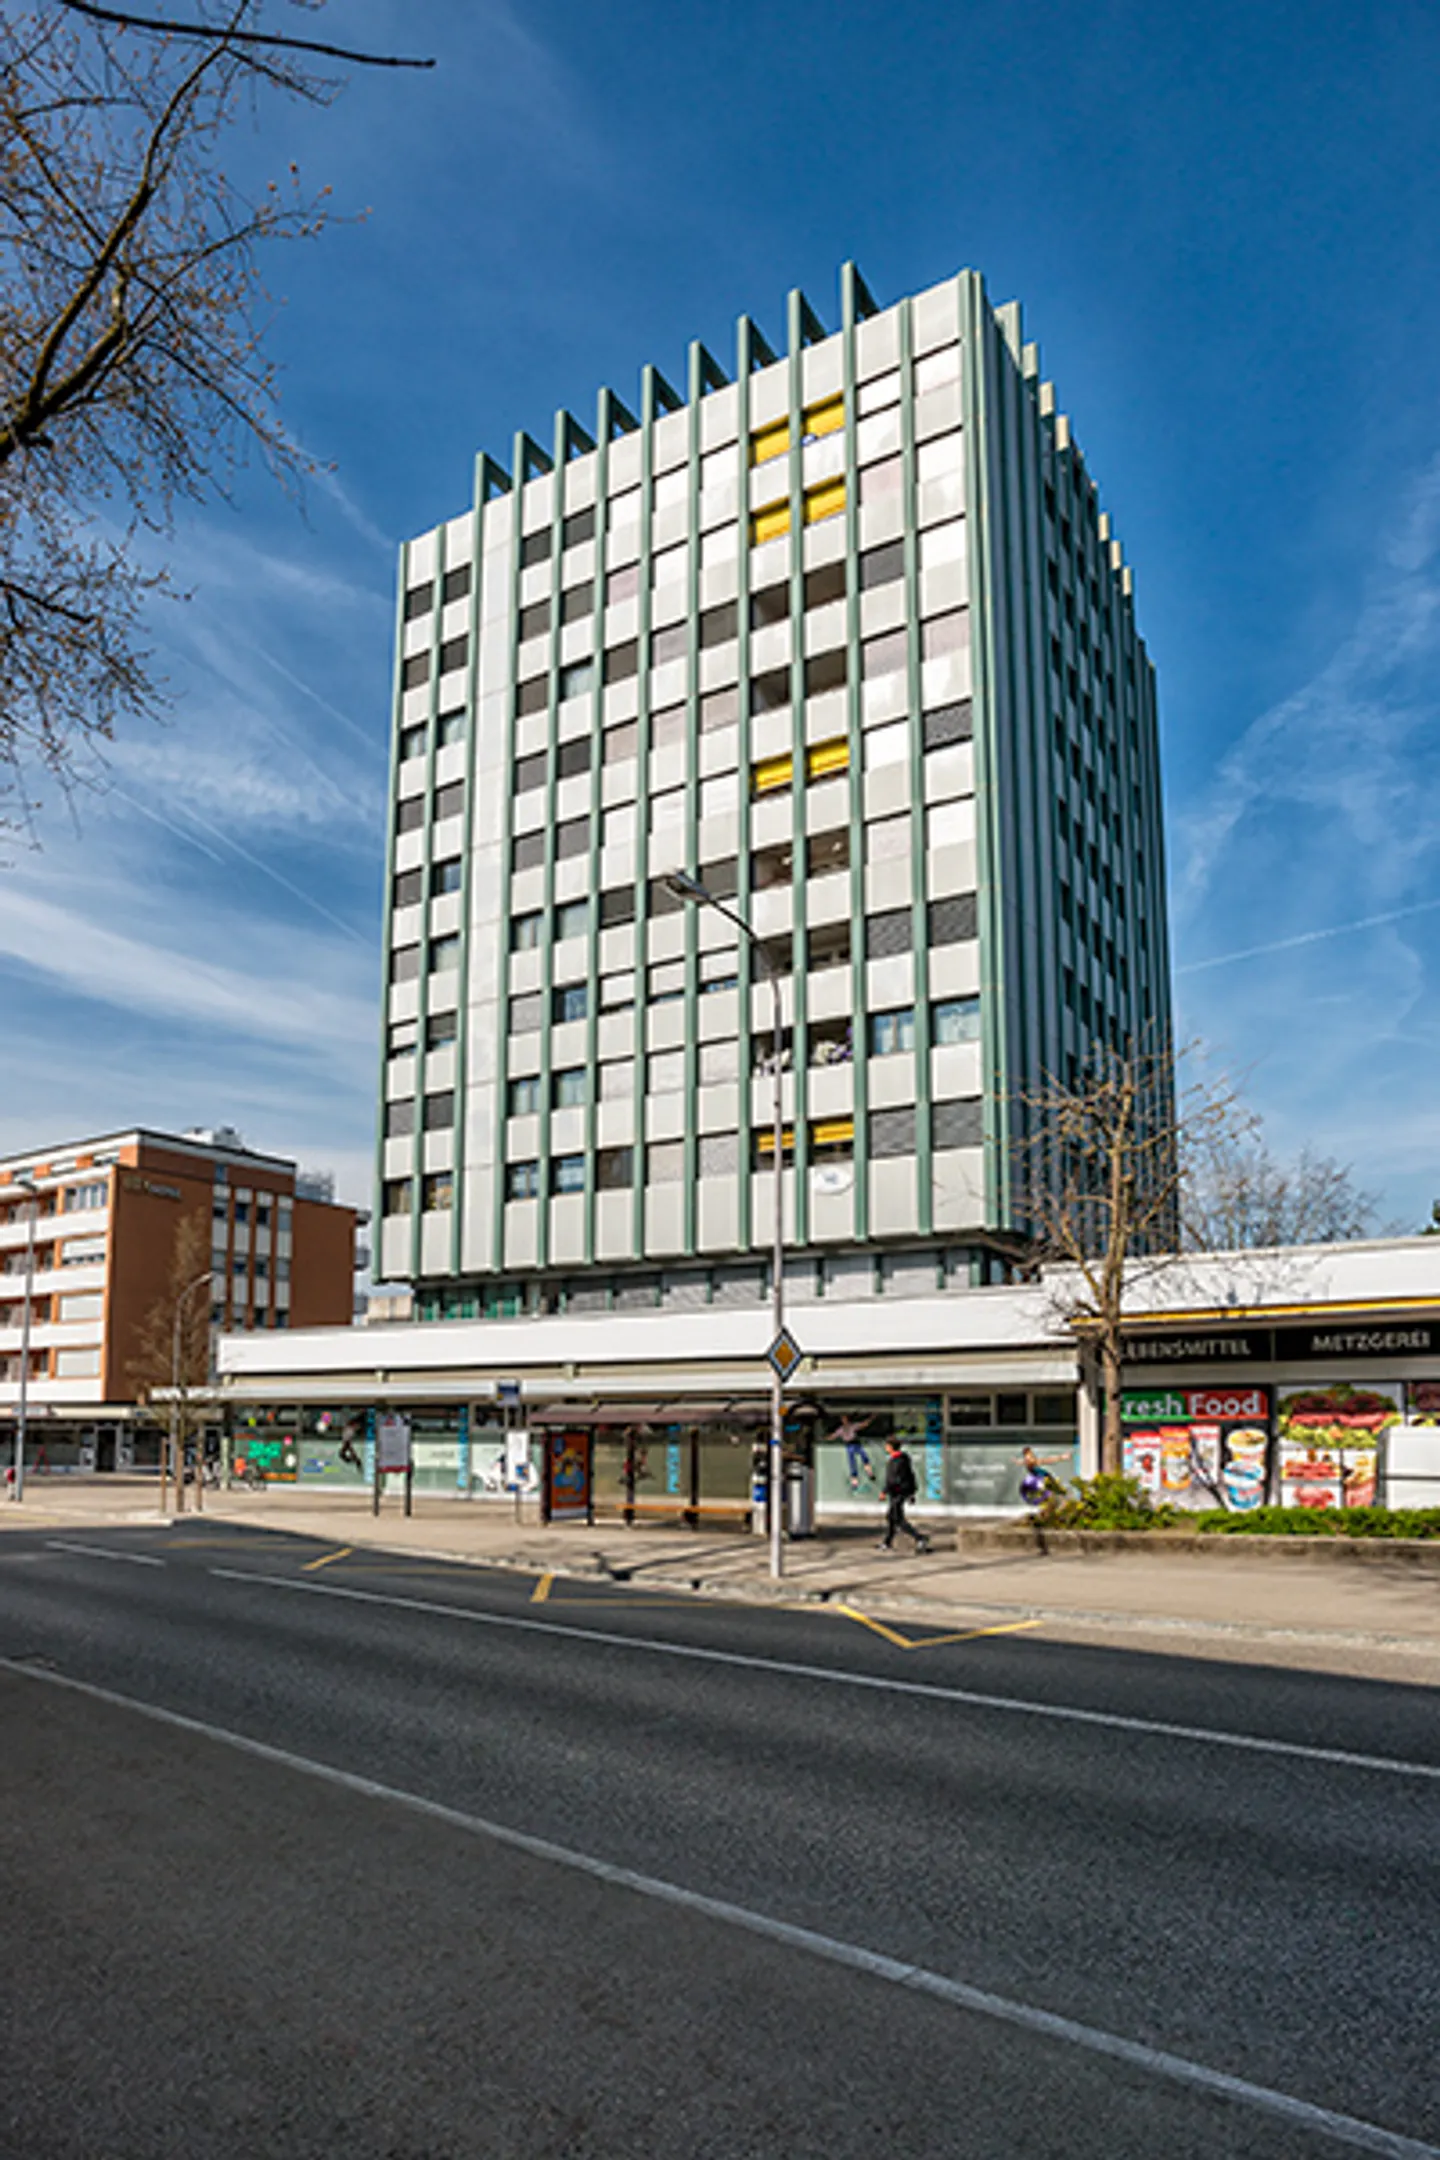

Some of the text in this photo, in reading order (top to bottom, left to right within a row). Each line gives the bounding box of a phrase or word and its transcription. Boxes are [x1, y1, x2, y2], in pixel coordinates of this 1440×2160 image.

[1311, 1331, 1431, 1351] METZGEREI
[1120, 1391, 1262, 1416] resh Food
